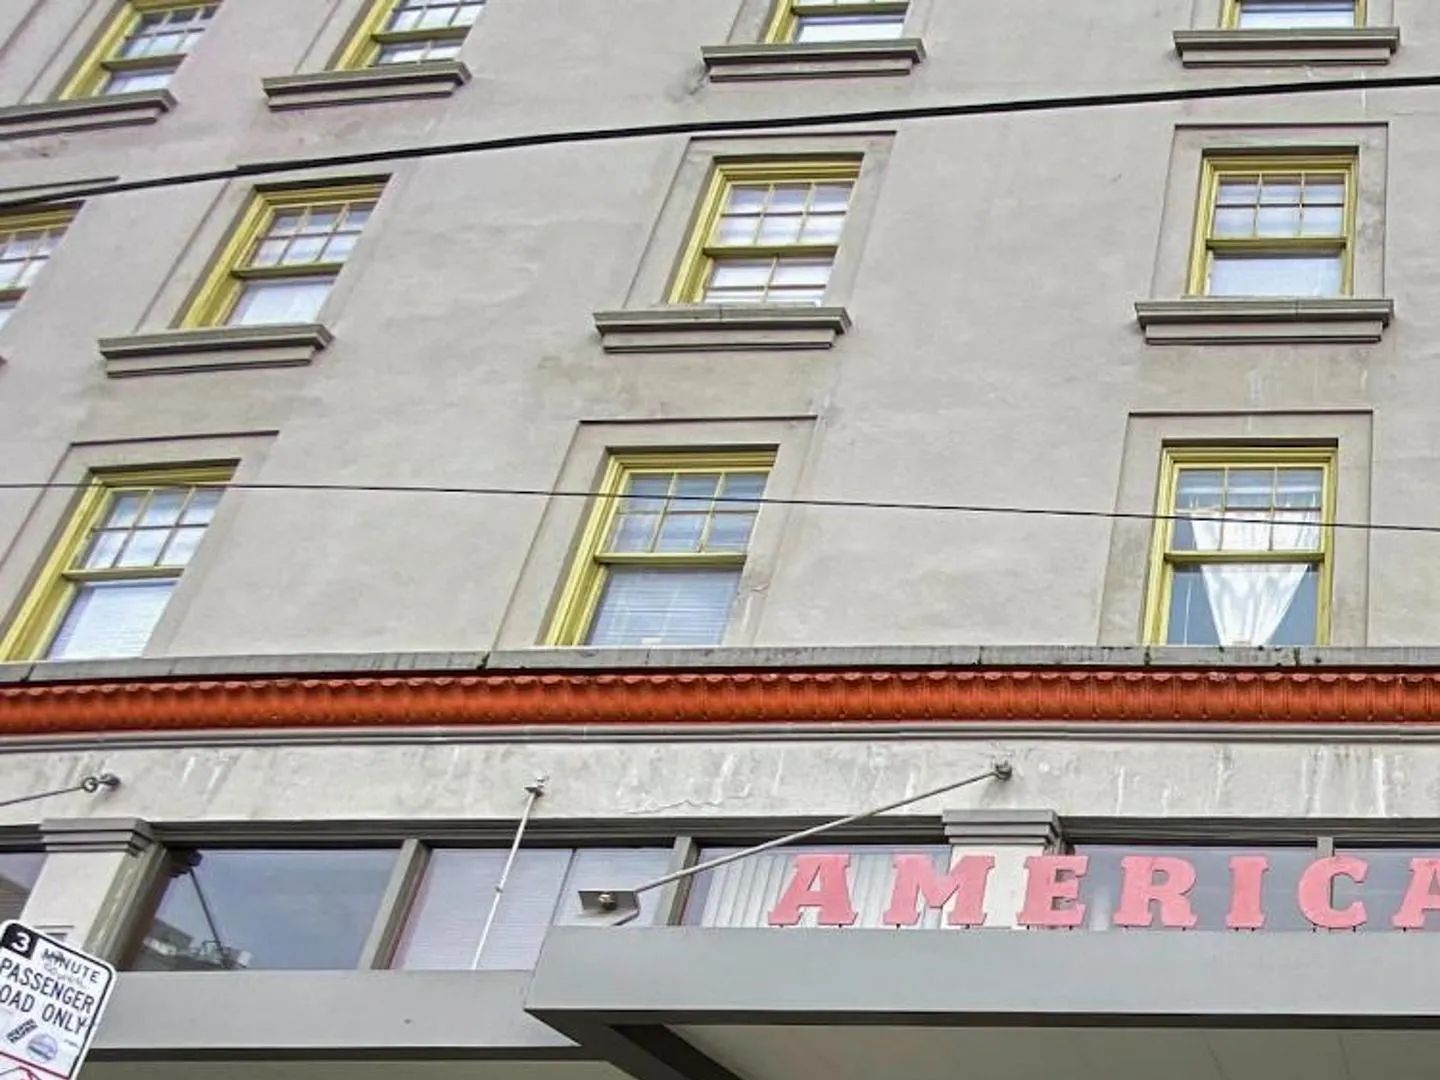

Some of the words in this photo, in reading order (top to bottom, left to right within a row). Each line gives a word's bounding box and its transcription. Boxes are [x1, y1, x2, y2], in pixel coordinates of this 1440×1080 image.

[12, 932, 31, 952] 3
[0, 957, 95, 1013] PASSENGER
[0, 984, 35, 1012] OAD
[42, 1003, 87, 1035] ONLY
